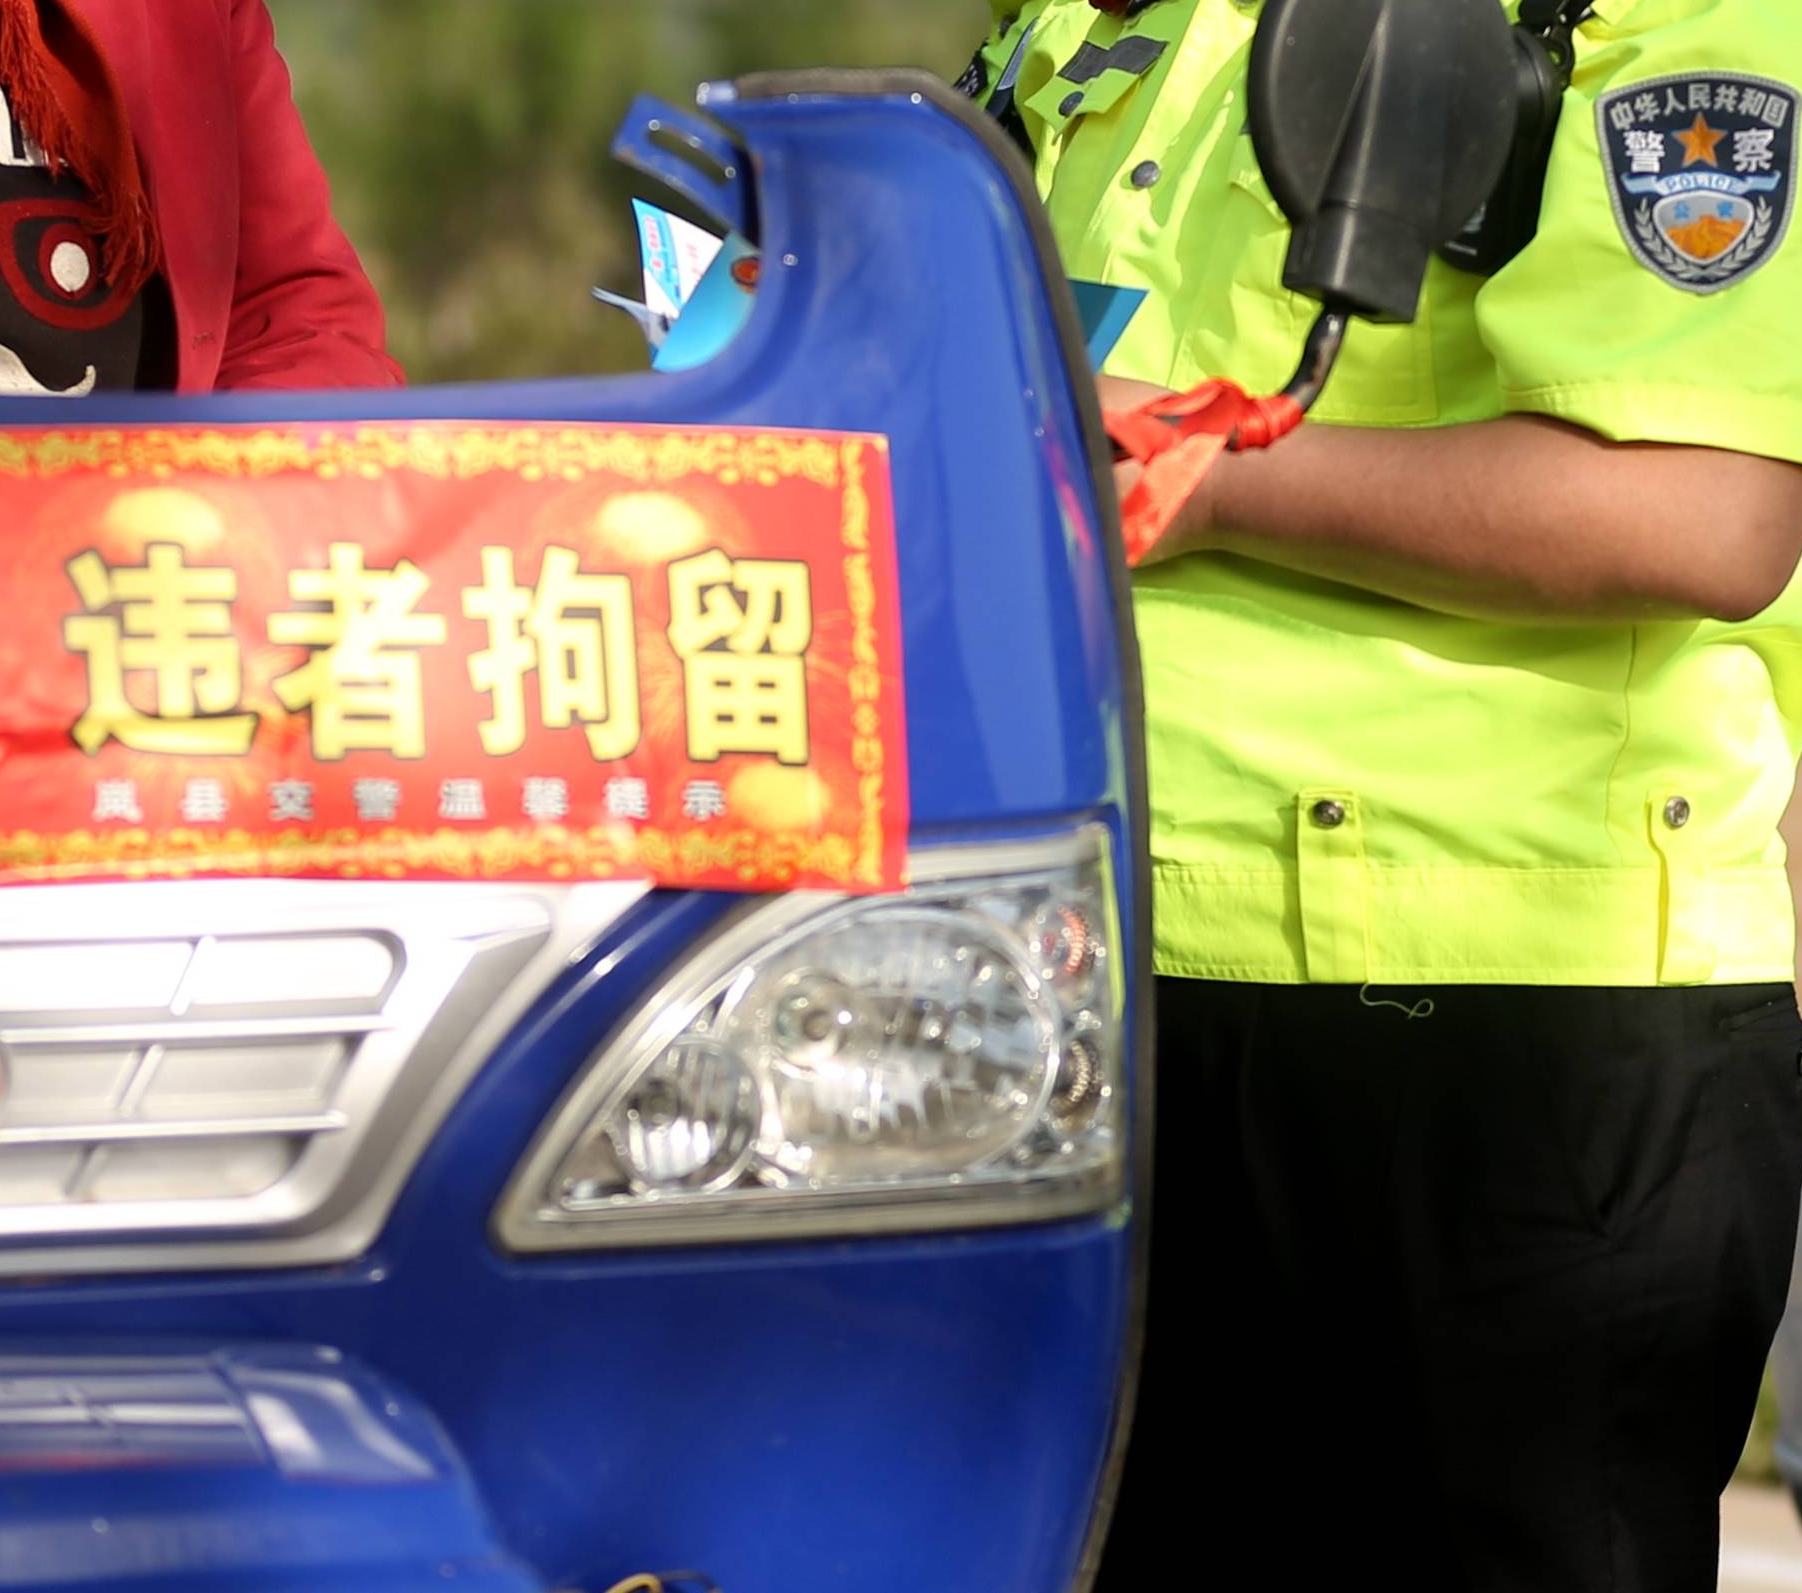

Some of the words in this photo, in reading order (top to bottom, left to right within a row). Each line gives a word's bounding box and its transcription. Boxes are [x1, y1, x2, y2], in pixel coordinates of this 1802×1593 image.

[1609, 82, 1790, 130] 中华人民共和国
[1623, 127, 1775, 173] 警察
[61, 542, 814, 766] 违者拘留
